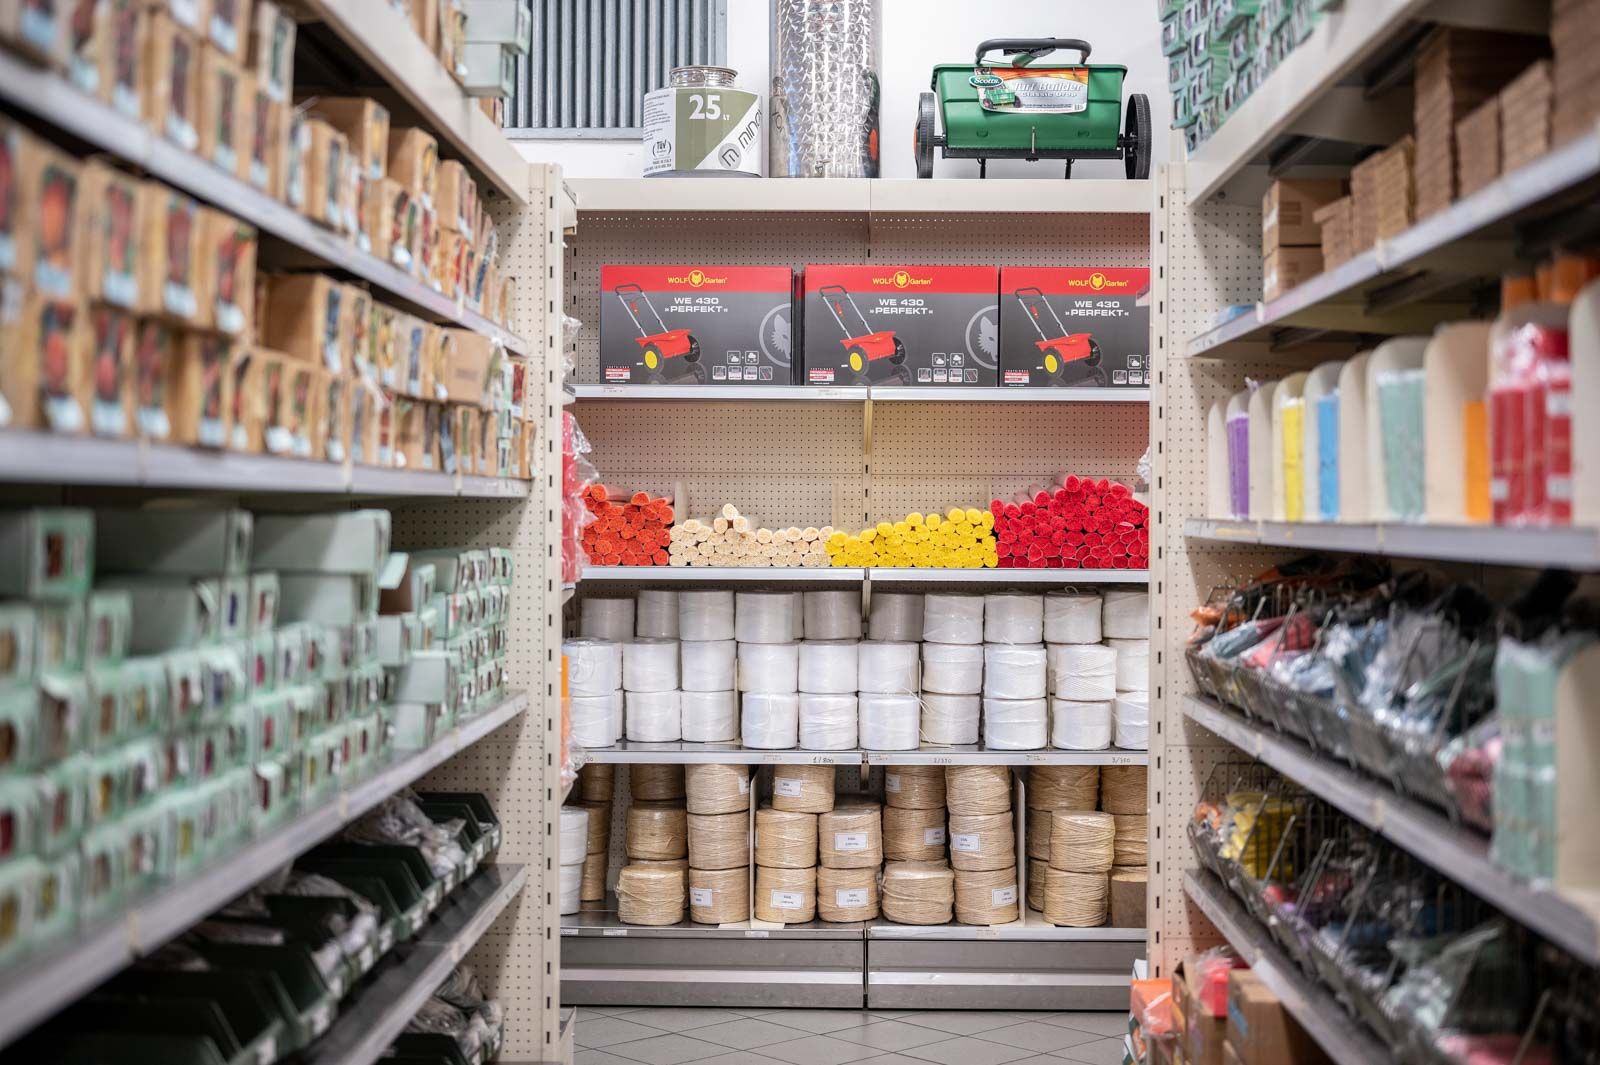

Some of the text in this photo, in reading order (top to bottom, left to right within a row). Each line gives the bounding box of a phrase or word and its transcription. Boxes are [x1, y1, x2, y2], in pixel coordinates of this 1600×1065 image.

[1039, 82, 1082, 92] Builder
[689, 94, 721, 120] 25
[1068, 279, 1089, 287] WOLF
[674, 297, 719, 305] WE 430
[879, 298, 924, 306] WE 430
[1074, 300, 1093, 308] WE
